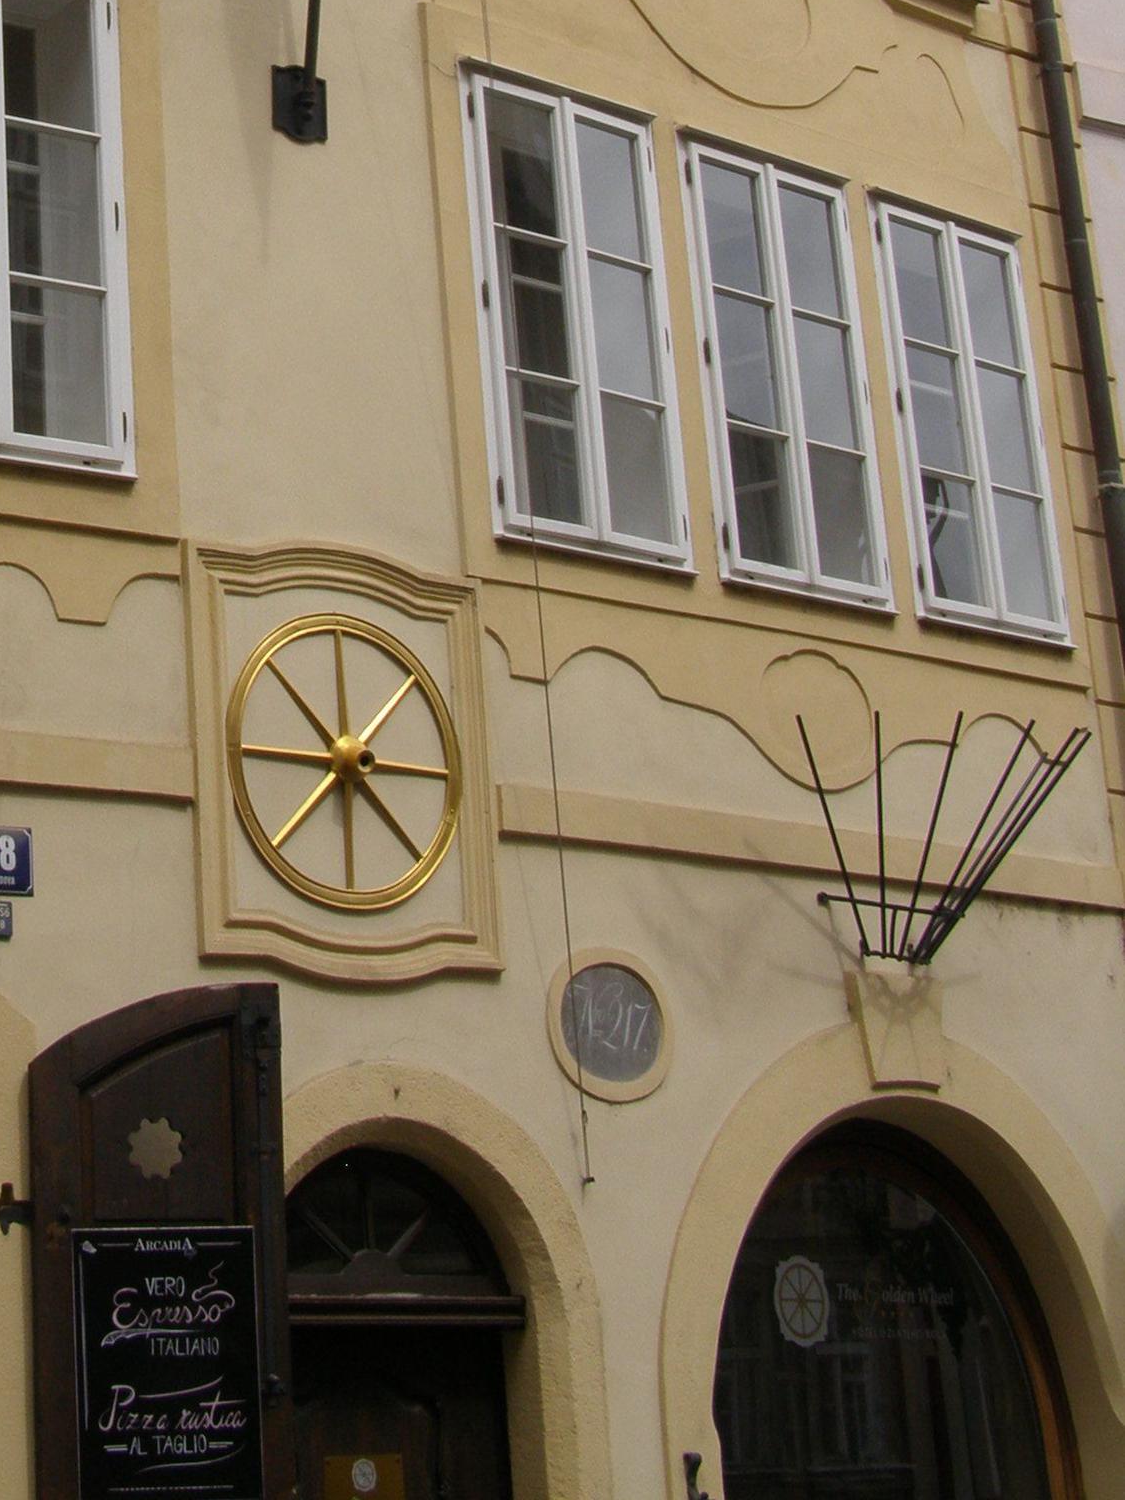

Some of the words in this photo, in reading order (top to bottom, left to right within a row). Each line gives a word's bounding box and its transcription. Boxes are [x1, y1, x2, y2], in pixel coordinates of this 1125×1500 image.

[134, 1237, 194, 1252] ARCADIA
[145, 1277, 186, 1297] VERO
[112, 1287, 223, 1338] Espresso
[150, 1337, 220, 1357] ITALIANO
[98, 1383, 169, 1432] Pizza
[129, 1437, 148, 1456] AL
[153, 1435, 209, 1454] TAGLIO
